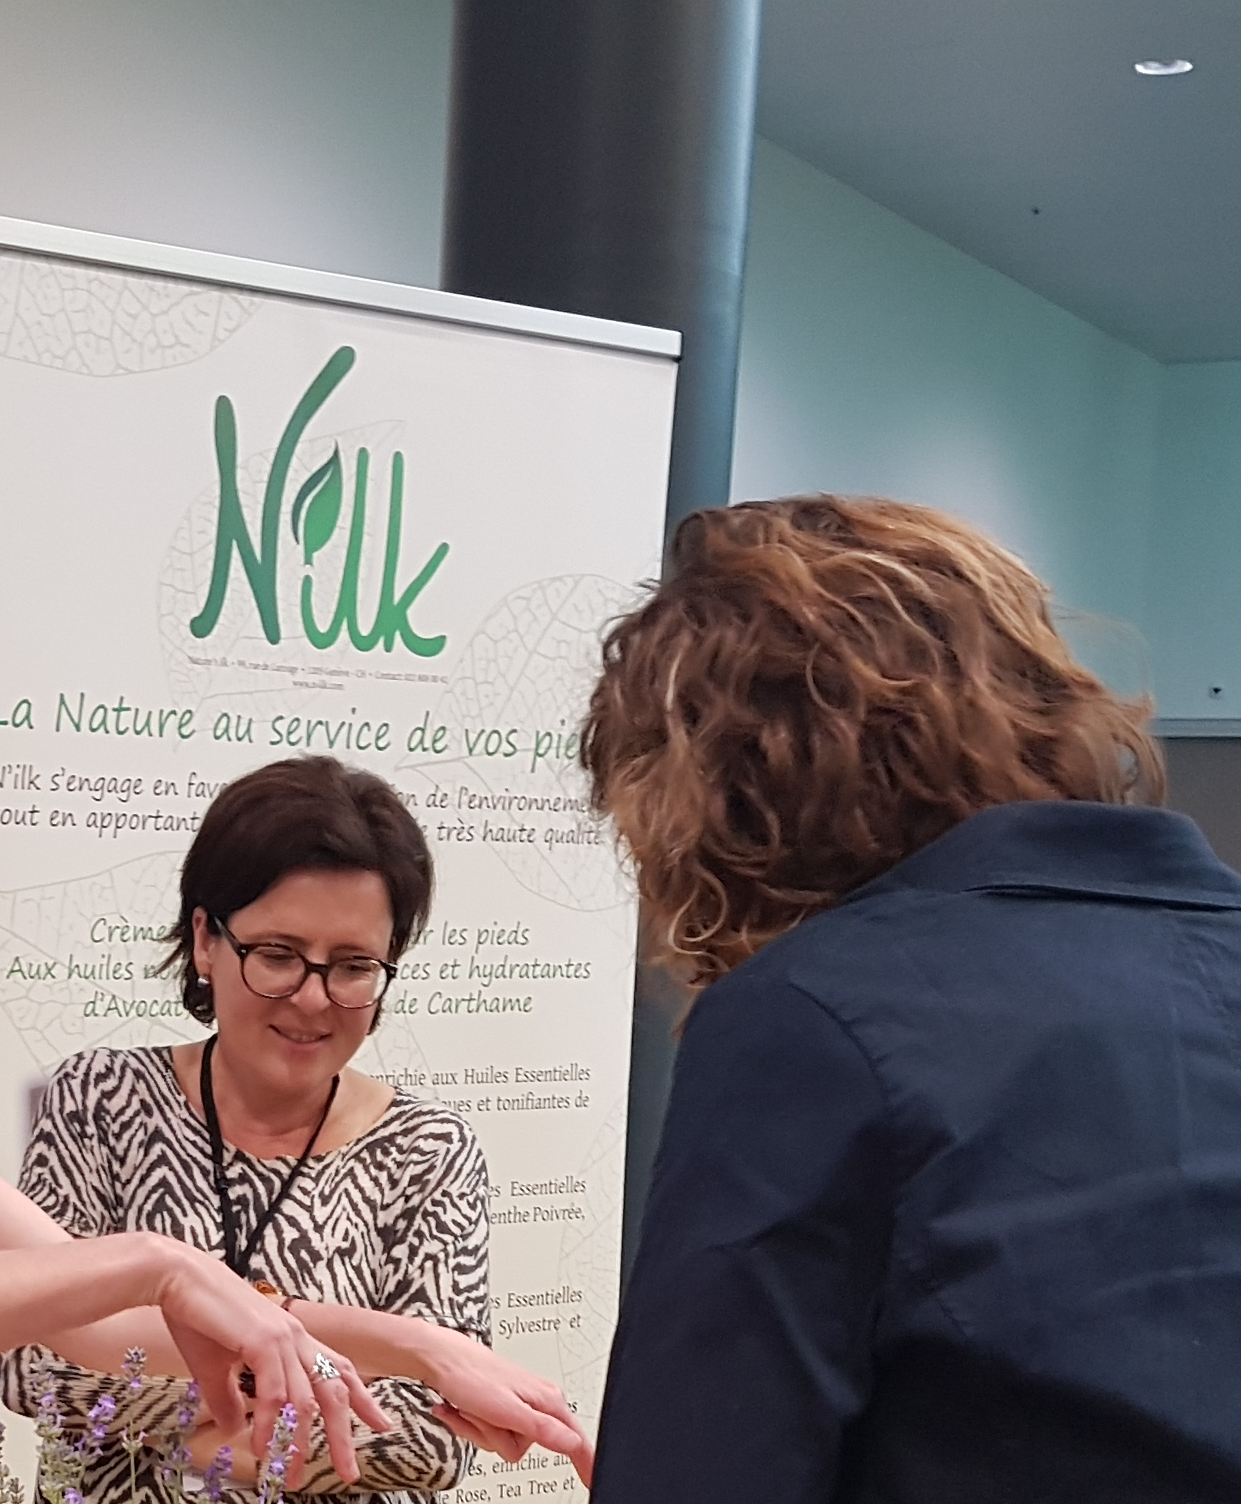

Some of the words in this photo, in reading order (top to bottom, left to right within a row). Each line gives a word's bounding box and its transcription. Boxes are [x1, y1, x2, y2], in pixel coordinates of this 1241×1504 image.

[55, 692, 196, 740] Nature
[213, 711, 254, 744] au
[269, 707, 391, 751] service
[407, 711, 449, 754] de
[464, 728, 518, 757] vos
[530, 719, 582, 773] pie
[50, 767, 143, 802] s'engage
[153, 779, 178, 797] en
[426, 785, 448, 808] de
[49, 810, 77, 828] en
[86, 808, 200, 838] apportant
[436, 817, 475, 843] très
[482, 819, 535, 844] haute
[441, 921, 468, 945] les
[475, 920, 530, 954] pieds
[6, 956, 59, 981] Aux
[67, 953, 135, 981] huiles
[439, 958, 462, 980] et
[468, 955, 592, 987] hydratantes
[393, 990, 419, 1015] de
[427, 990, 533, 1016] Carthame
[431, 1070, 458, 1086] aux
[463, 1065, 509, 1085] Huiles
[514, 1062, 592, 1083] Essentielles
[477, 1097, 491, 1111] et
[496, 1091, 571, 1111] tonifiantes
[574, 1089, 590, 1109] de
[510, 1175, 586, 1198] Essentielles
[490, 1205, 529, 1225] enthe
[533, 1203, 586, 1224] Poivrée,
[507, 1286, 583, 1309] Essentielles
[498, 1315, 561, 1340] Sylvestre
[570, 1314, 582, 1329] et
[456, 1488, 491, 1504] Rose,
[496, 1483, 521, 1499] Tea
[528, 1479, 558, 1495] Tree
[563, 1476, 575, 1491] et
